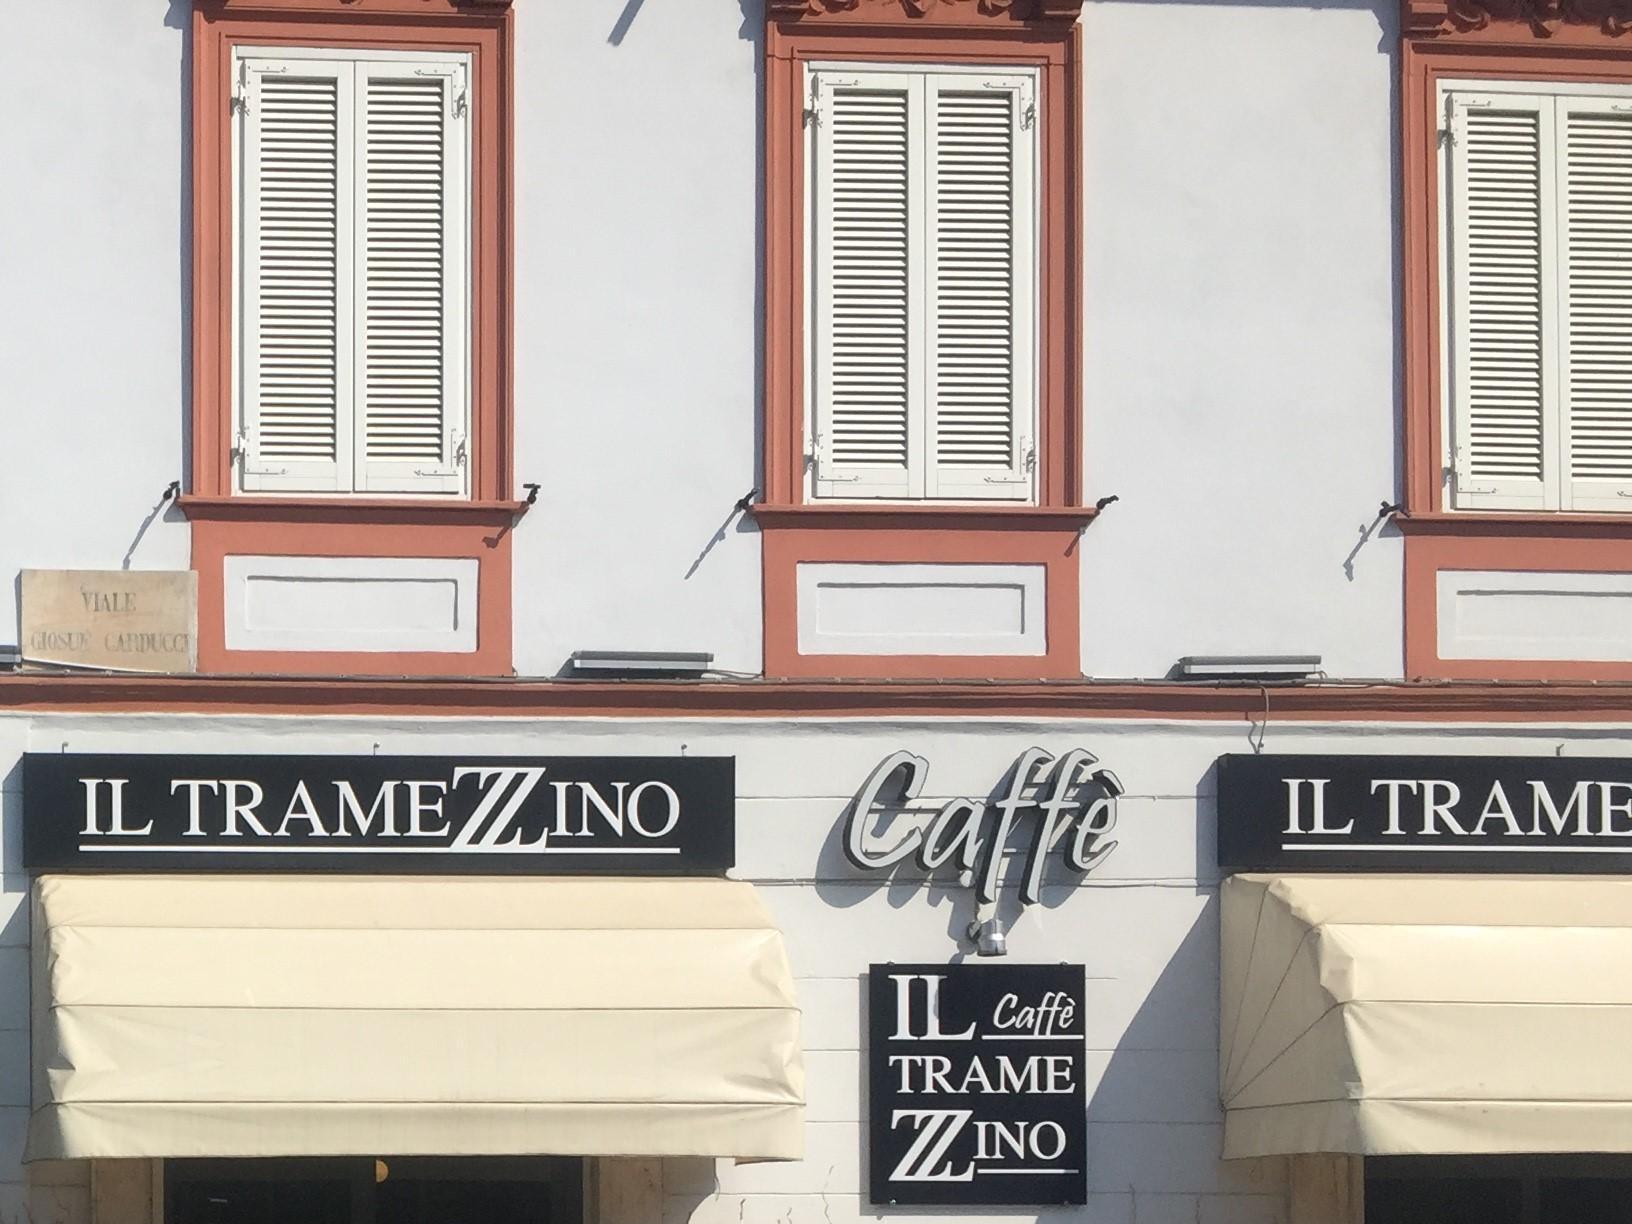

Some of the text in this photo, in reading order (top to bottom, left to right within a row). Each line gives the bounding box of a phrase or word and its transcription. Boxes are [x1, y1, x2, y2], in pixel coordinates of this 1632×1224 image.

[81, 591, 137, 612] VIALE
[104, 631, 191, 653] CARDUCCI
[79, 767, 681, 853] IL TRAMEZZINO
[850, 746, 1125, 902] Caffè
[1281, 778, 1355, 835] IL
[887, 974, 1076, 1041] IL Caffè
[888, 1055, 1076, 1094] TRAME
[888, 1109, 1067, 1182] ZZINO
